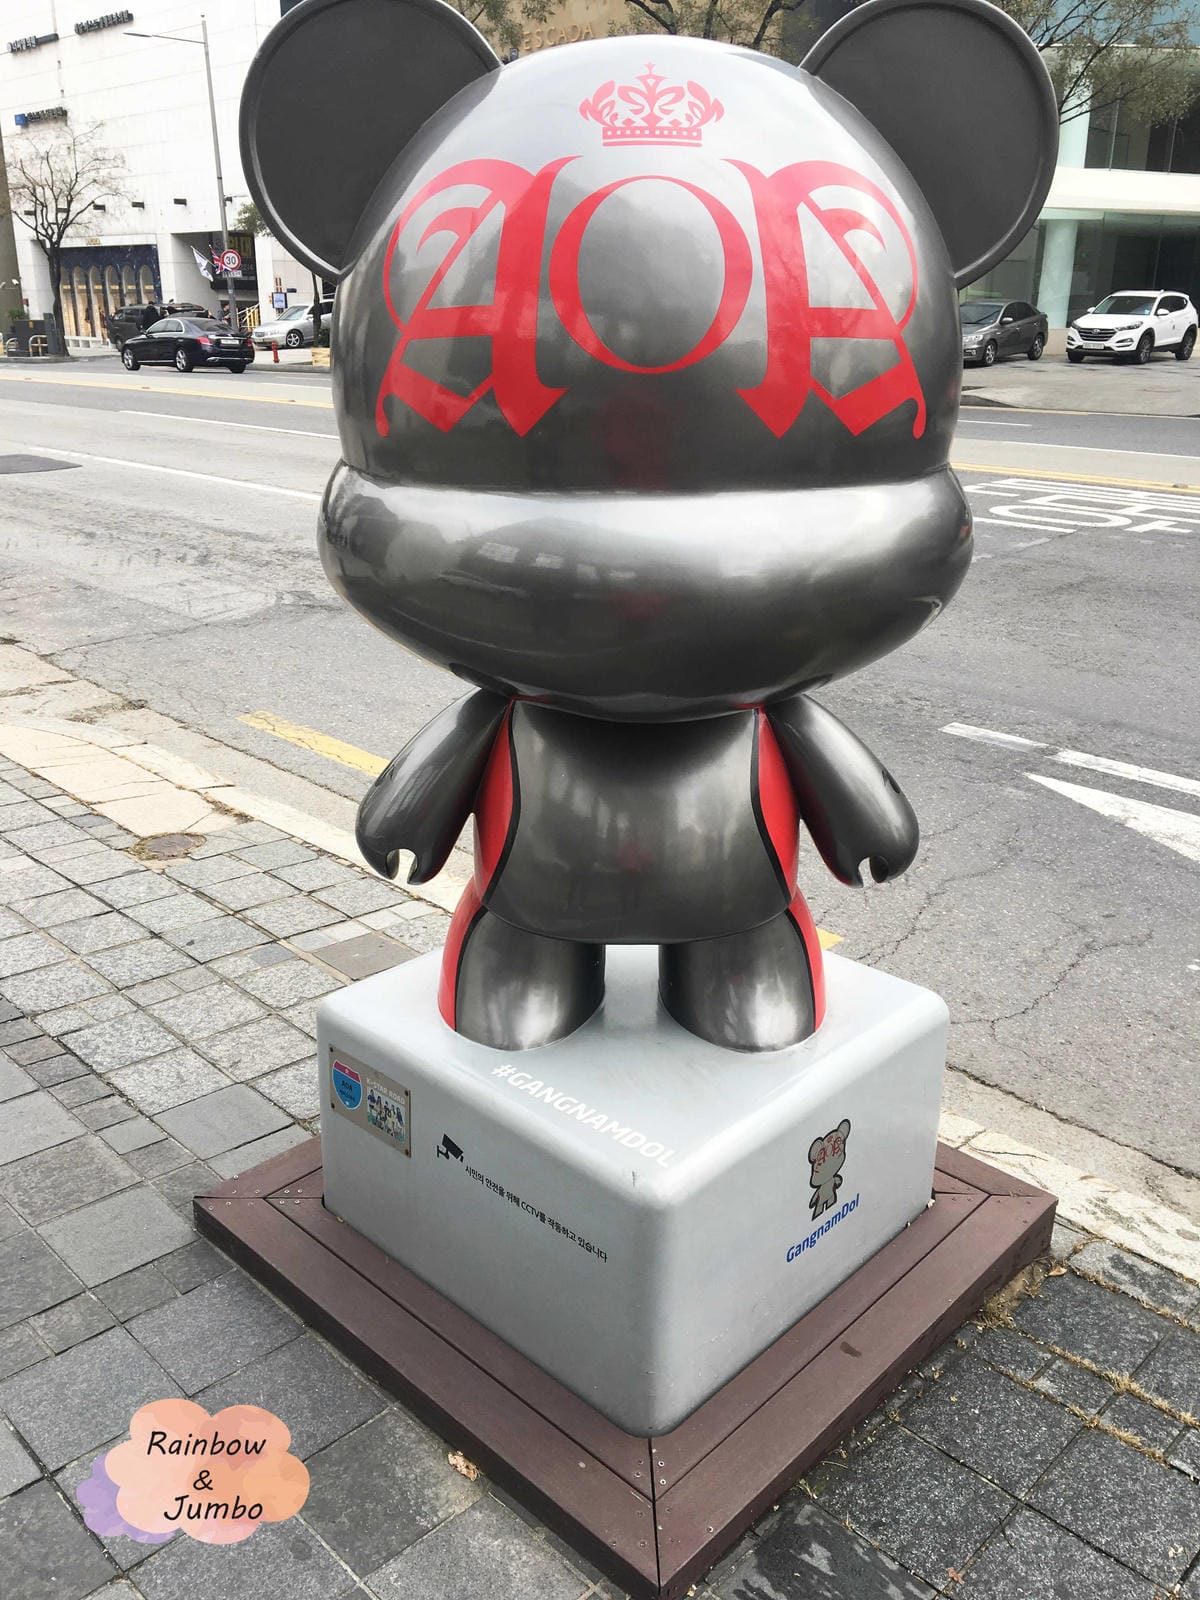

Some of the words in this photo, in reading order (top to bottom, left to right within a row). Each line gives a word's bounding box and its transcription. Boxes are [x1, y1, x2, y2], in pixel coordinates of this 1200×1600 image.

[523, 24, 594, 50] ESCADA
[225, 255, 236, 265] 30
[389, 1089, 405, 1105] ROAD
[491, 1064, 679, 1169] #GANGNAMDOL
[465, 1165, 484, 1185] 시민의
[485, 1178, 505, 1198] 안전을
[506, 1191, 521, 1208] 위해
[521, 1201, 546, 1224] CCTV를
[547, 1217, 576, 1242] 작동하고
[577, 1237, 608, 1263] 있습니다
[786, 1193, 860, 1263] GangnamDol
